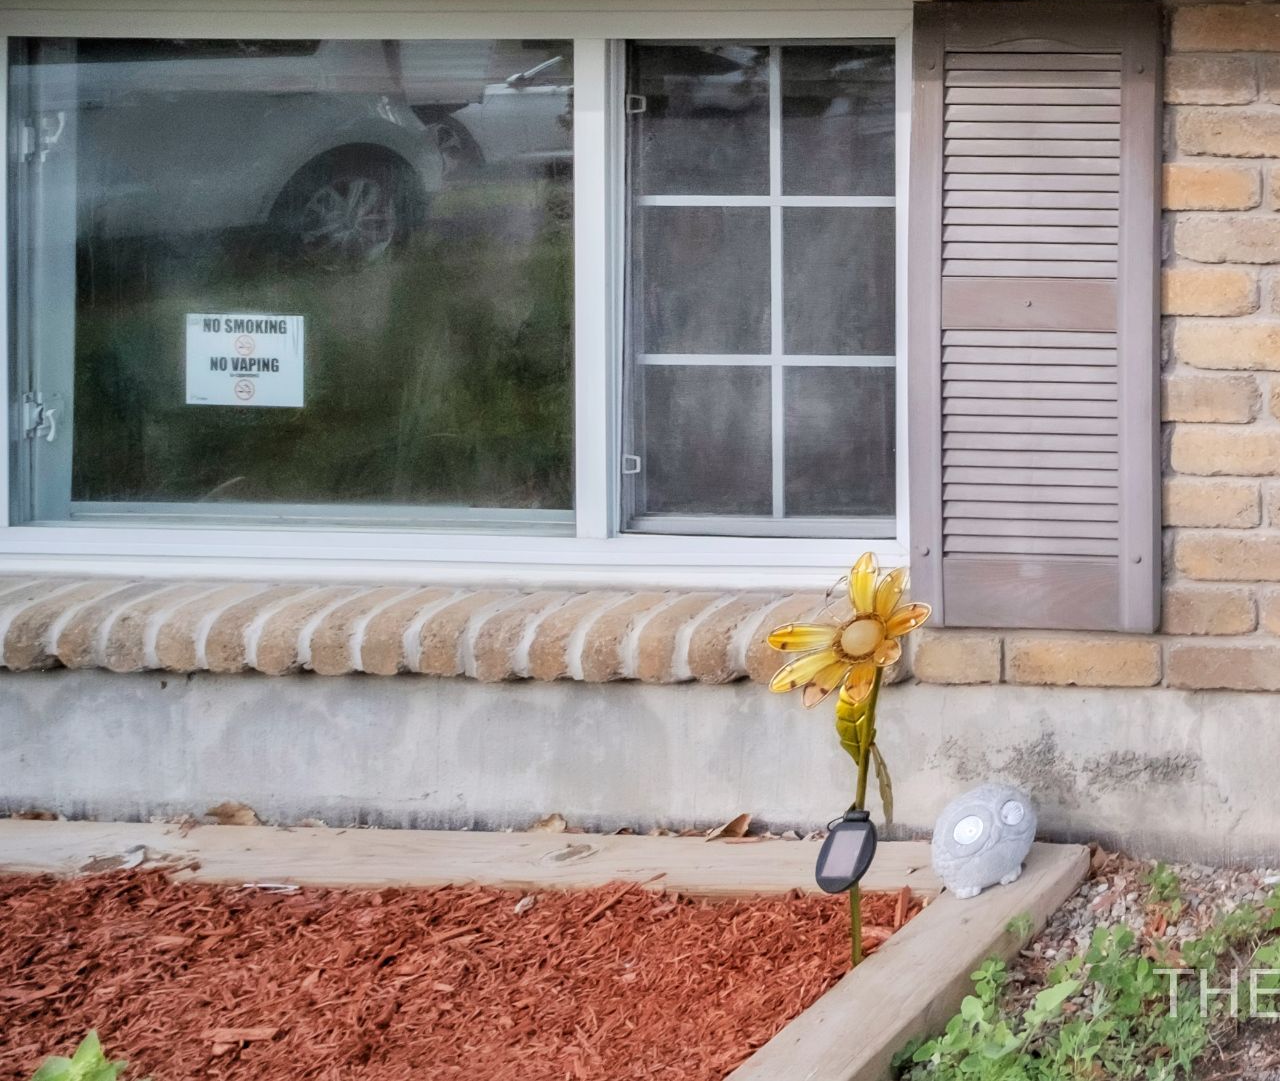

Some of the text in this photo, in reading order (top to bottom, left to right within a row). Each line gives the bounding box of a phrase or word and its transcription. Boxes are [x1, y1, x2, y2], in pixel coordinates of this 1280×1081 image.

[203, 318, 287, 334] NO SMOKING
[210, 356, 279, 372] NO VAPING
